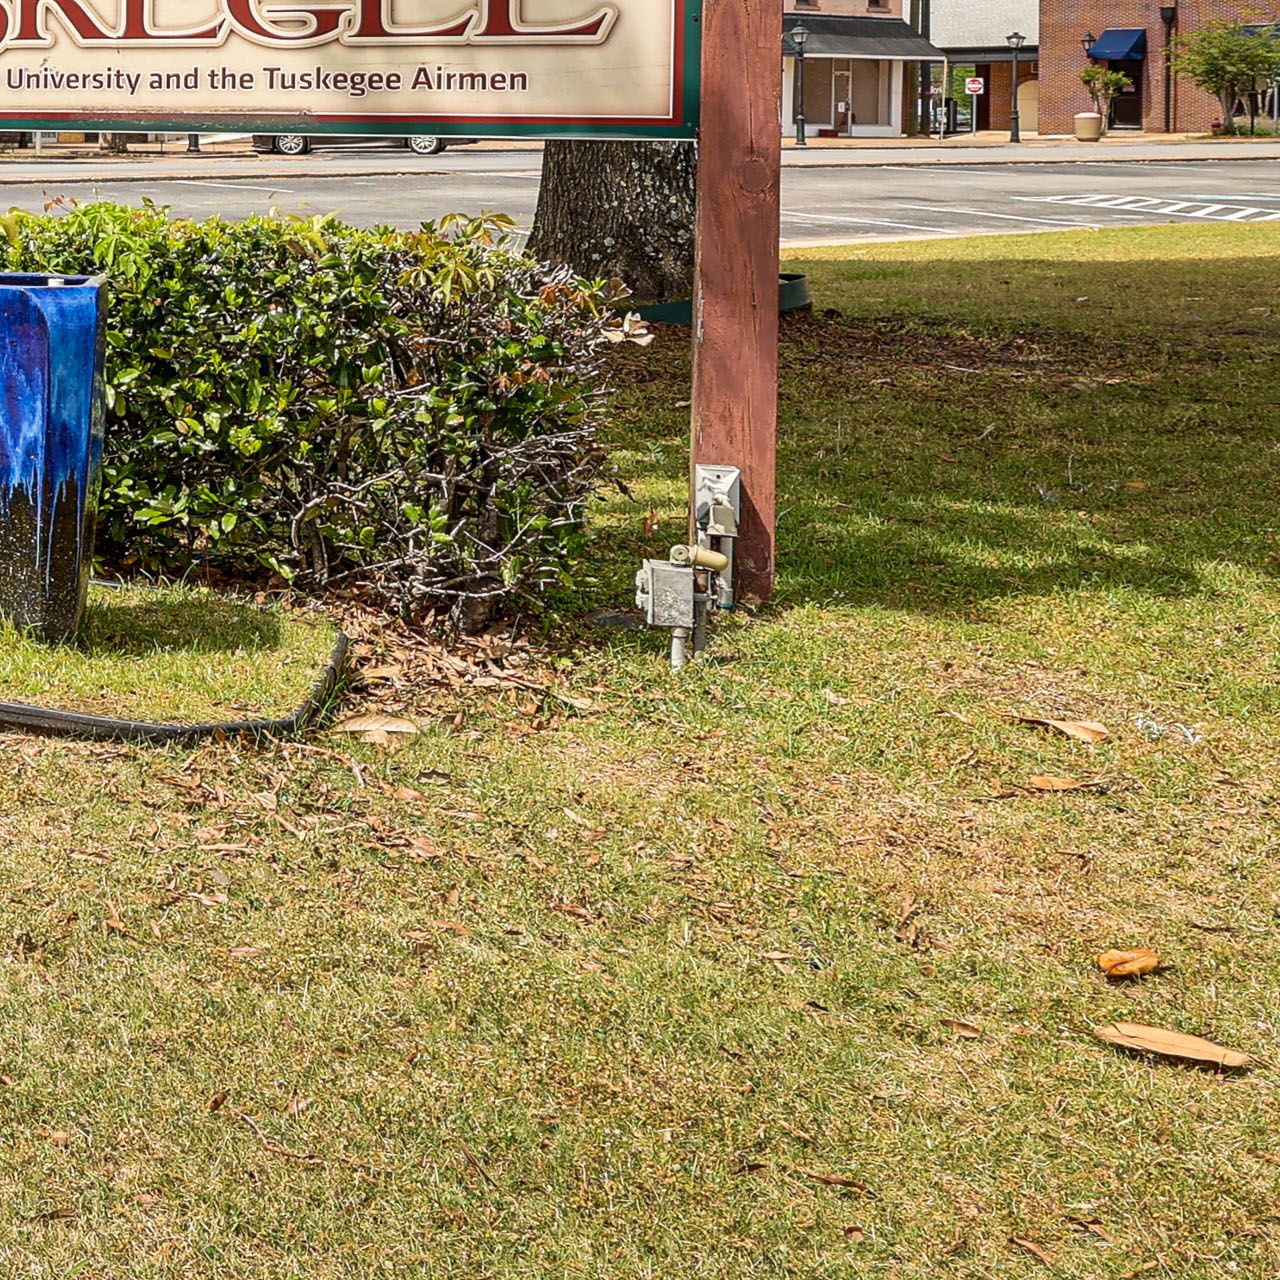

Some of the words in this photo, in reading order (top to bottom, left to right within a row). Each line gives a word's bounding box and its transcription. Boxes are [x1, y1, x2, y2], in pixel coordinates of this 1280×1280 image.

[7, 67, 141, 95] University
[149, 67, 199, 91] and
[208, 67, 255, 91] the
[262, 66, 402, 98] Tuskegee
[410, 66, 528, 92] Airmen
